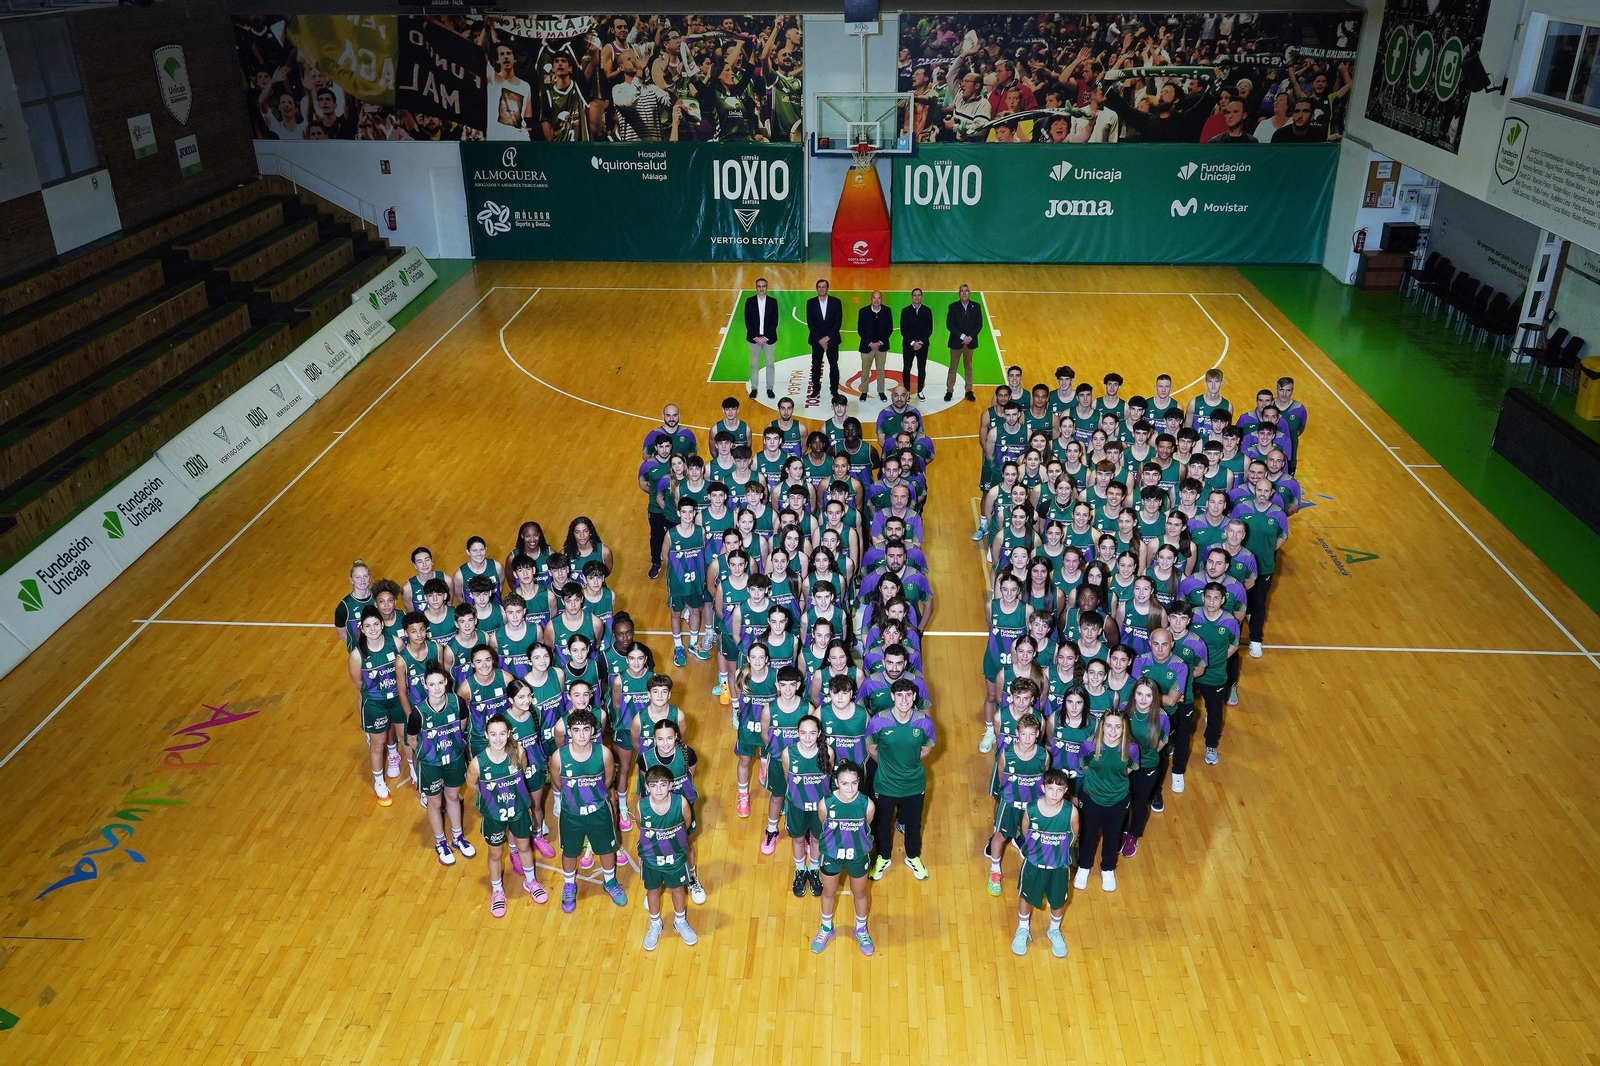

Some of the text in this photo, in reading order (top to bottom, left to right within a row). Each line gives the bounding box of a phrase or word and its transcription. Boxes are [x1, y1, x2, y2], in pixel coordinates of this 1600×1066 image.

[638, 151, 667, 159] Hospital
[602, 160, 667, 173] quirónsalud
[1201, 163, 1251, 173] Fundación
[474, 170, 547, 181] ALMOGUERA
[642, 173, 667, 181] Málaga
[1074, 168, 1122, 183] Unicaja
[1200, 172, 1236, 183] Unicaja
[1204, 203, 1249, 213] Movistar
[711, 237, 785, 245] VERTIGO ESTATE
[374, 280, 397, 297] Fundación
[787, 370, 804, 397] MÁLAGA
[276, 395, 303, 418] VERTIGO ESTATE
[219, 437, 252, 465] VERTIGO ESTATE
[116, 476, 165, 517] Fundación
[127, 496, 164, 527] Unicaja
[36, 533, 94, 584] Fundación
[47, 556, 92, 597] Unicaja
[684, 571, 696, 583] 29
[438, 726, 460, 737] Unicaja
[747, 721, 761, 733] 46
[437, 740, 453, 752] Mijas
[498, 777, 522, 789] Unicaja
[497, 793, 516, 804] Mijas
[656, 832, 676, 841] Unicaja
[837, 848, 855, 859] 48
[657, 855, 675, 866] 54
